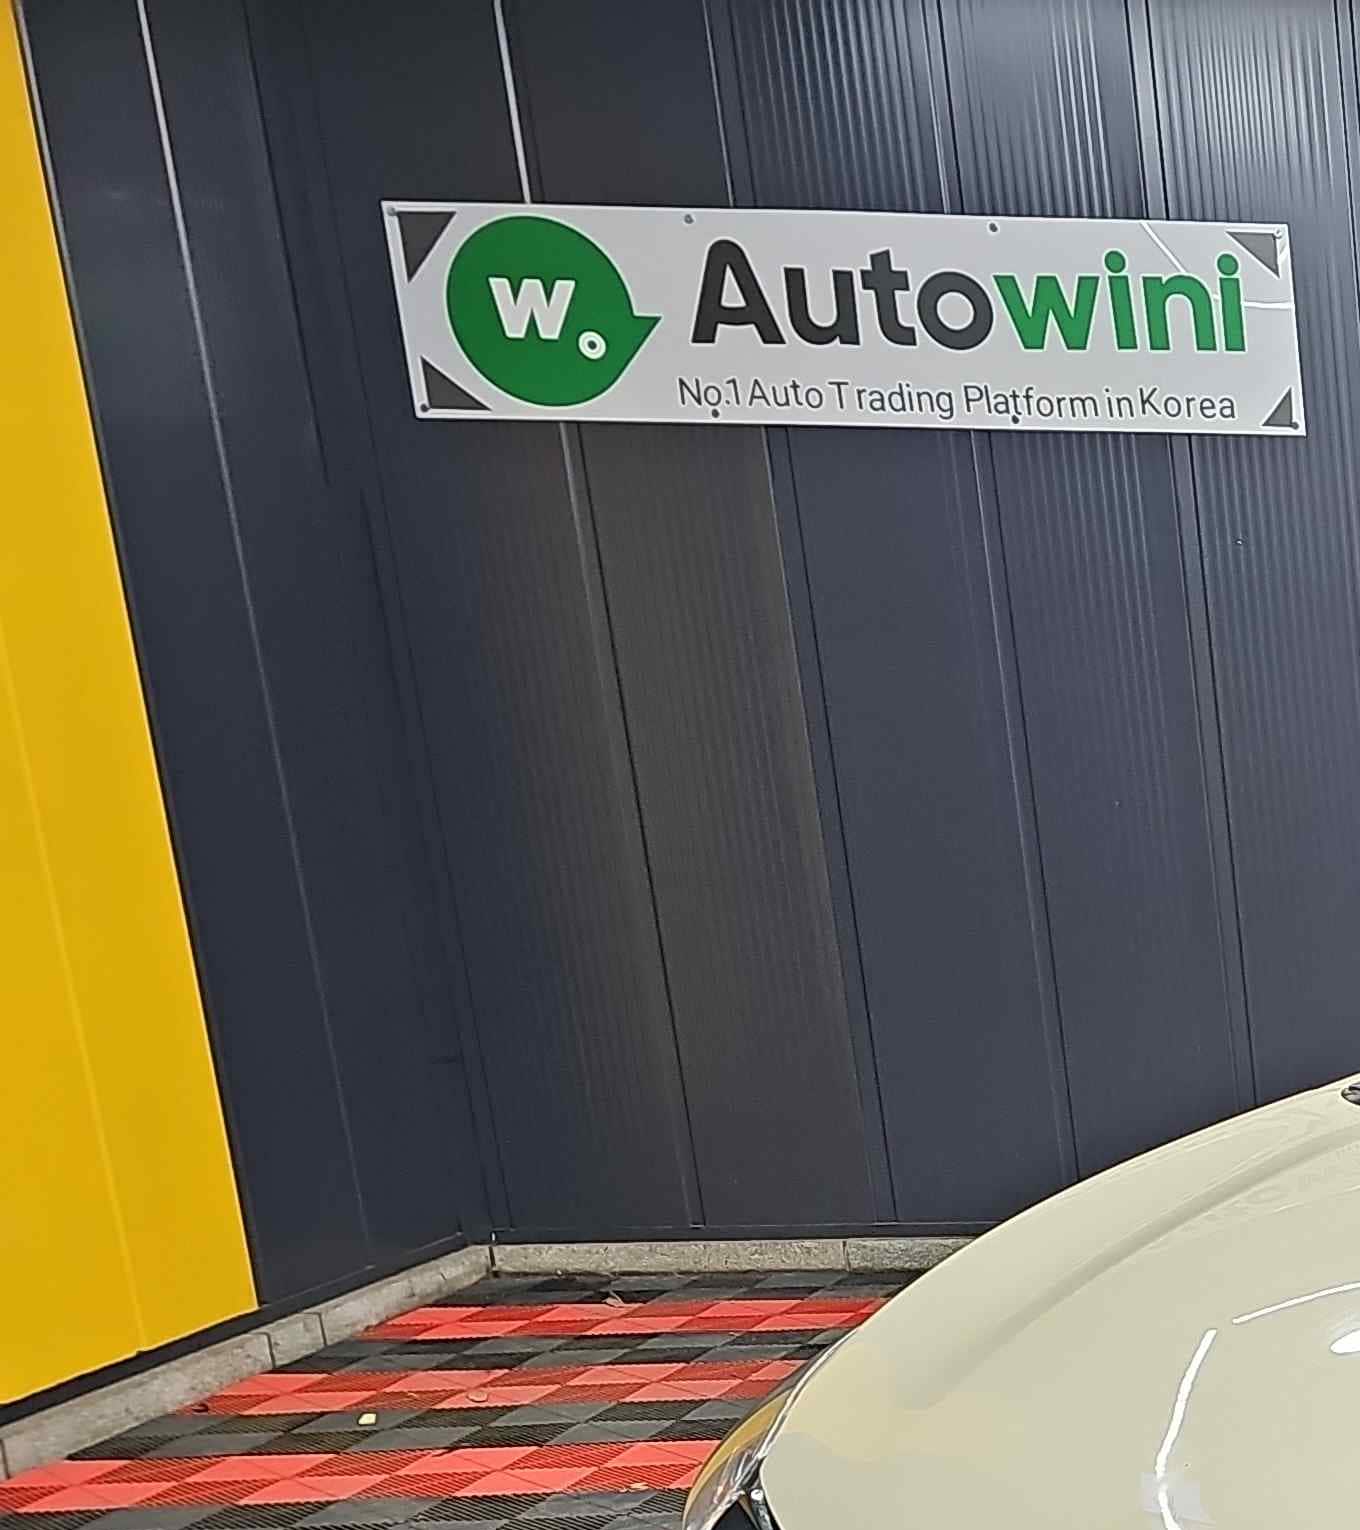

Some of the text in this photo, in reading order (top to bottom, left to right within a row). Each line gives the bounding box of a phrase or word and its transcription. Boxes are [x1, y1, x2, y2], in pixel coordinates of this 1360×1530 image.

[690, 239, 1246, 353] Autowini
[677, 376, 741, 407] No.1
[748, 378, 824, 409] Auto
[962, 384, 1100, 419] Platform
[1105, 387, 1135, 418] in
[1139, 386, 1237, 419] Korea
